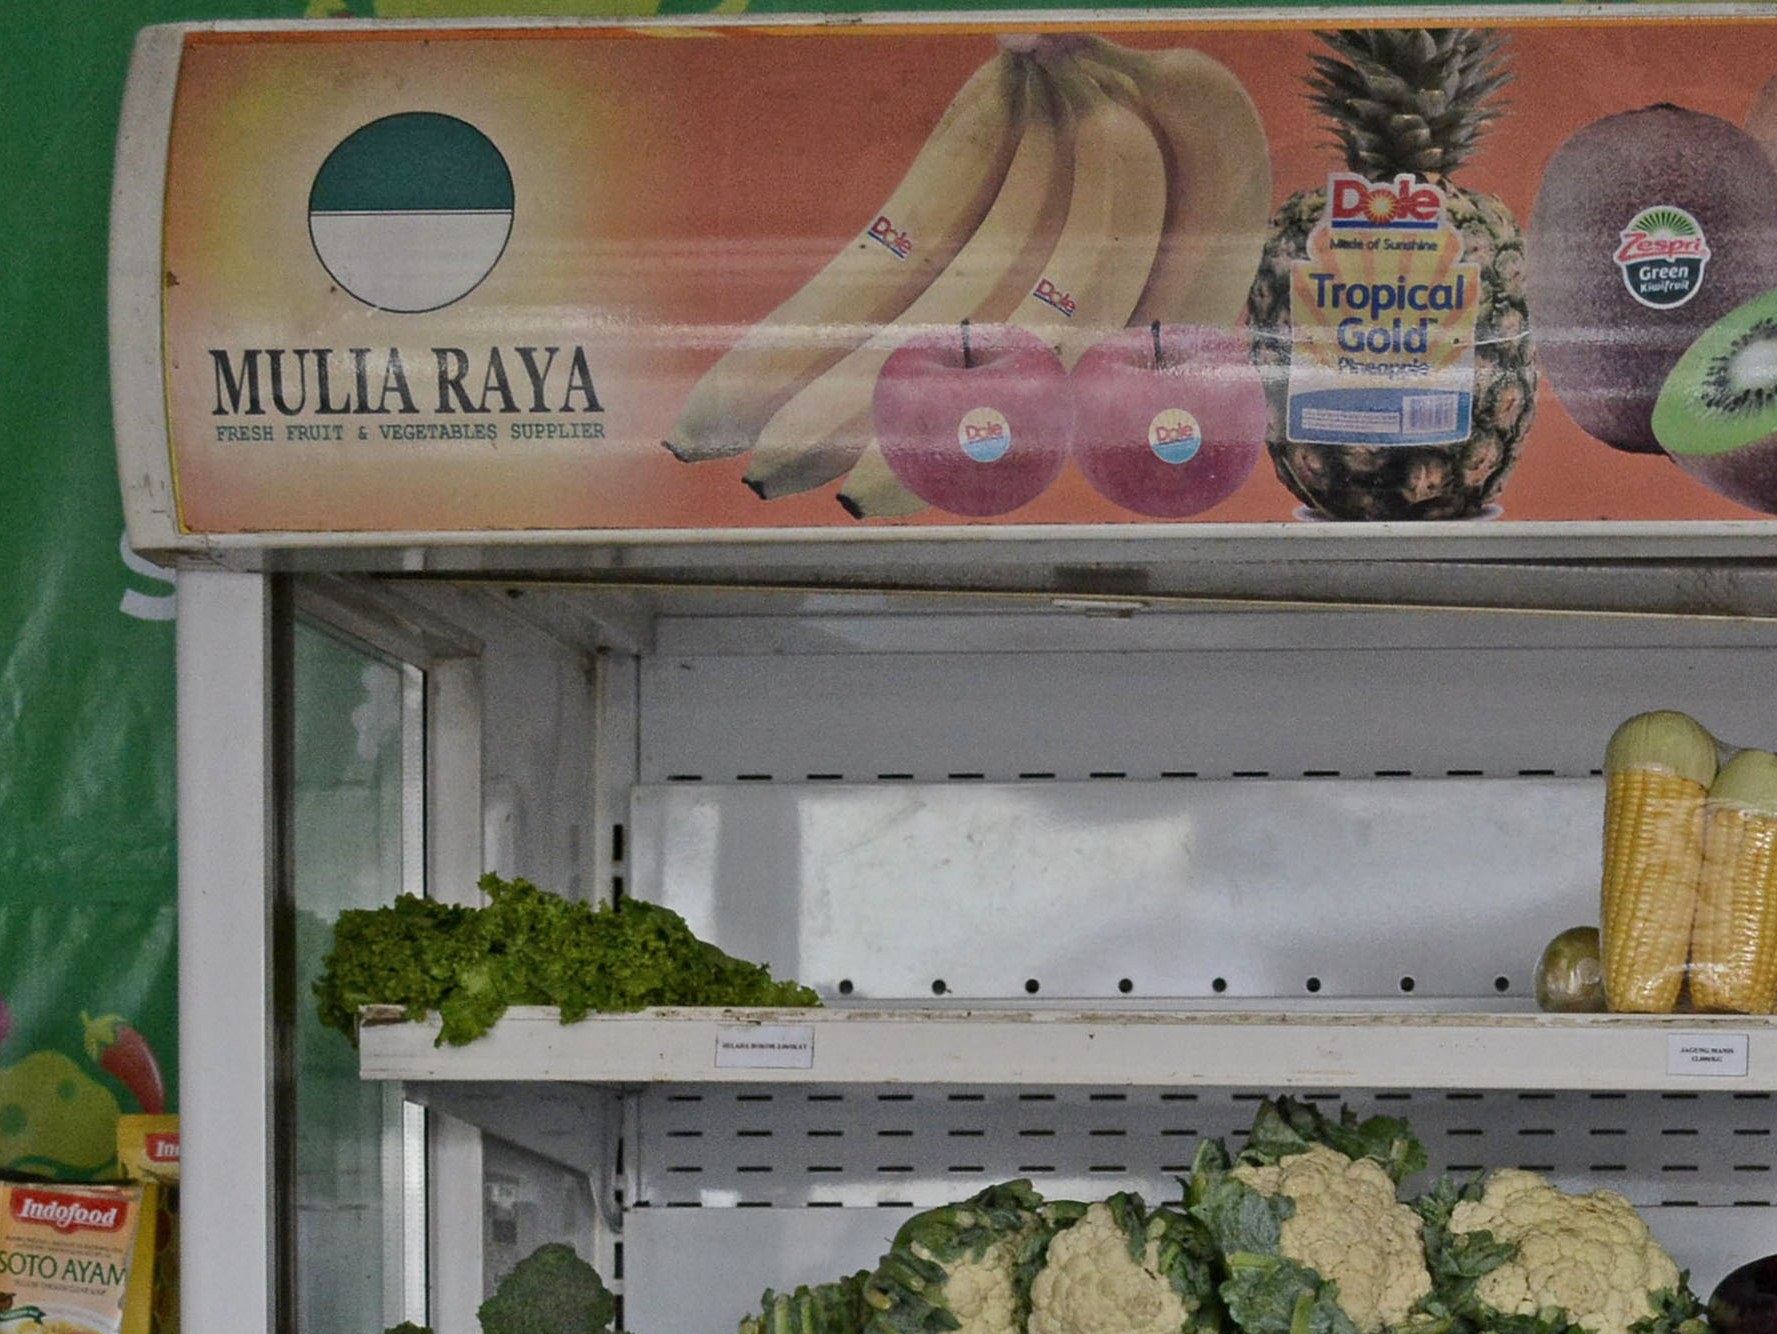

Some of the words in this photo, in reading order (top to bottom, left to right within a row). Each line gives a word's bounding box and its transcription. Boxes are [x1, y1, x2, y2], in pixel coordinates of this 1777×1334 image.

[1332, 179, 1441, 224] Dole
[871, 215, 913, 256] Dole
[1618, 232, 1704, 263] Zespri
[1639, 265, 1689, 281] Green
[1037, 278, 1078, 315] Dole
[1308, 272, 1464, 320] Tropical
[1337, 316, 1428, 354] Gold
[208, 346, 420, 416] MULIA
[431, 345, 605, 415] RAYA
[215, 424, 274, 441] FRESH
[286, 424, 344, 441] FRUIT
[357, 426, 369, 440] &
[380, 423, 499, 440] VEGETABLES
[510, 422, 606, 440] SUPPLIER
[964, 420, 1004, 441] Dole
[1154, 422, 1196, 443] Dole
[18, 1197, 120, 1228] Indofood
[0, 1250, 58, 1279] SOTO
[61, 1258, 127, 1287] AYAM
